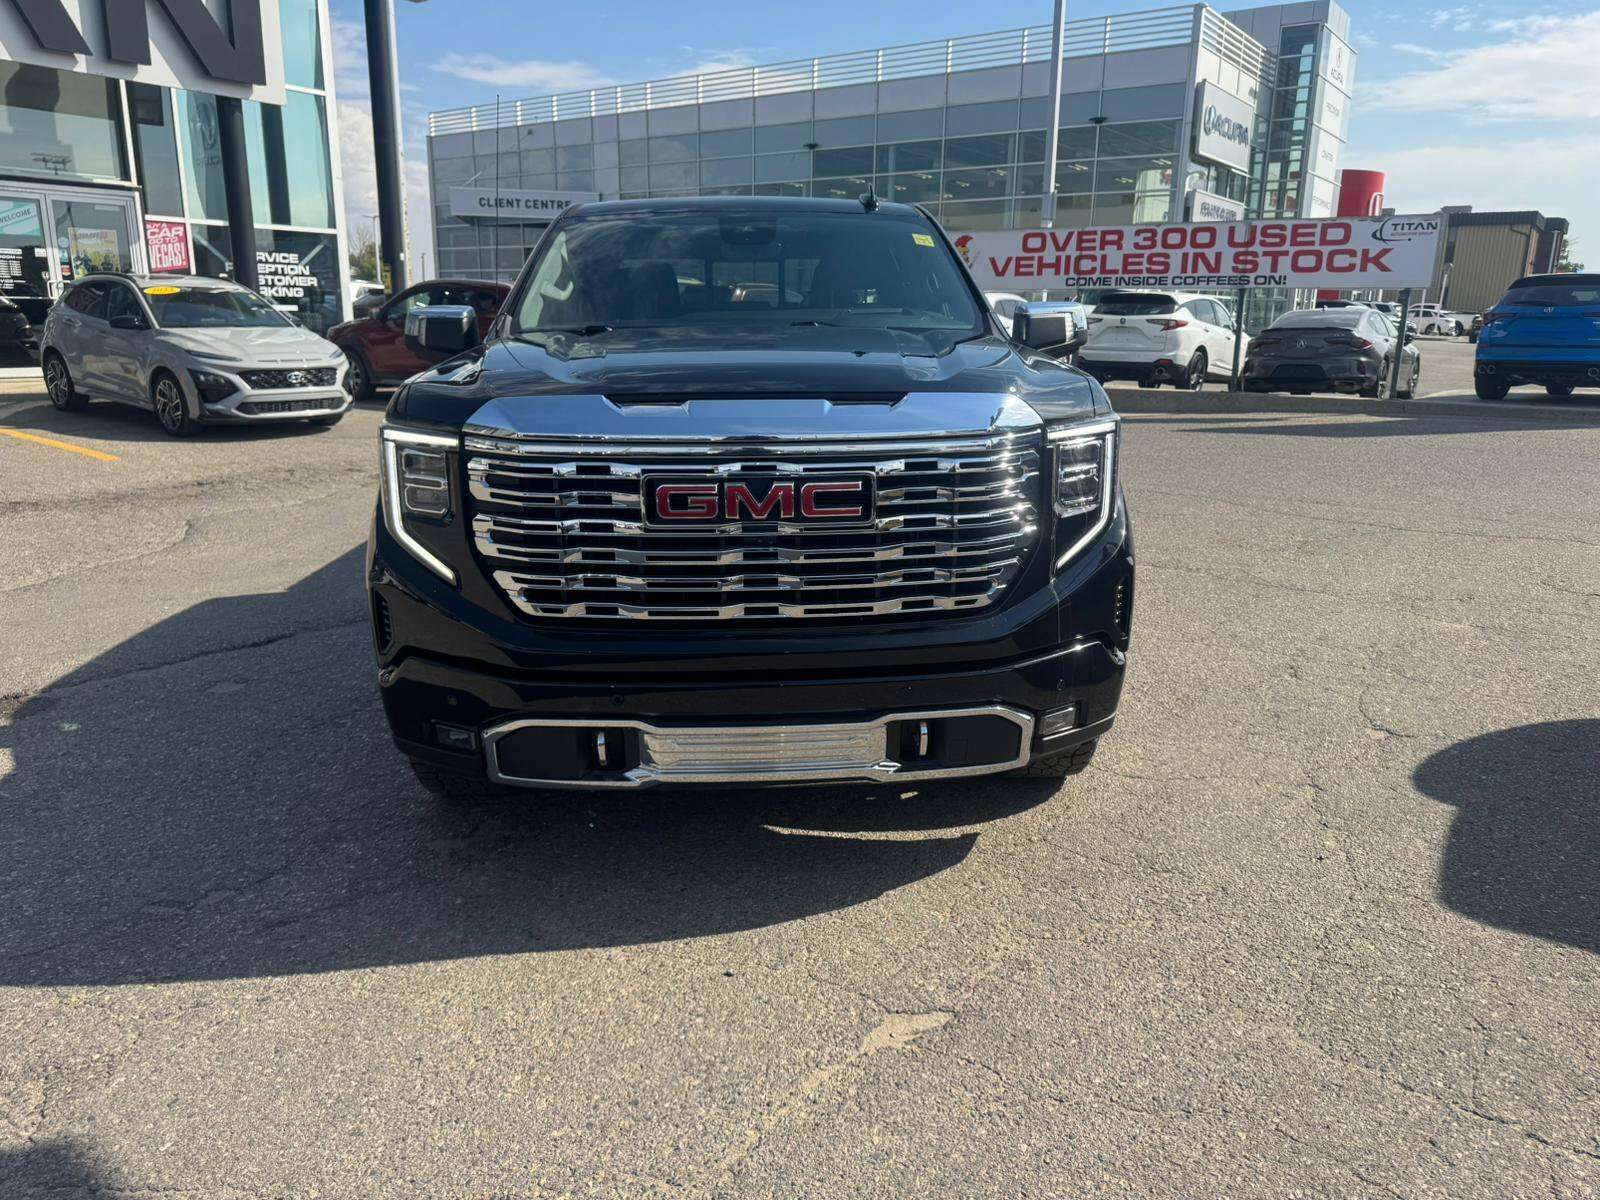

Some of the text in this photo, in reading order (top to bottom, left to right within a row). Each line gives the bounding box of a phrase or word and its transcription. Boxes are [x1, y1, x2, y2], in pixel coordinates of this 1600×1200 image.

[1215, 113, 1249, 148] ACURA
[479, 197, 521, 208] CLIENT
[147, 227, 184, 239] CAR
[1391, 222, 1438, 231] TITAN
[1022, 222, 1352, 253] OVER 300 USED
[149, 242, 187, 268] VEGAS!
[256, 252, 299, 263] RVICE
[989, 248, 1395, 277] VEHICLES IN STOCK
[1065, 275, 1287, 287] COME INSIDE COFFEES ON!
[656, 480, 862, 520] GMC
